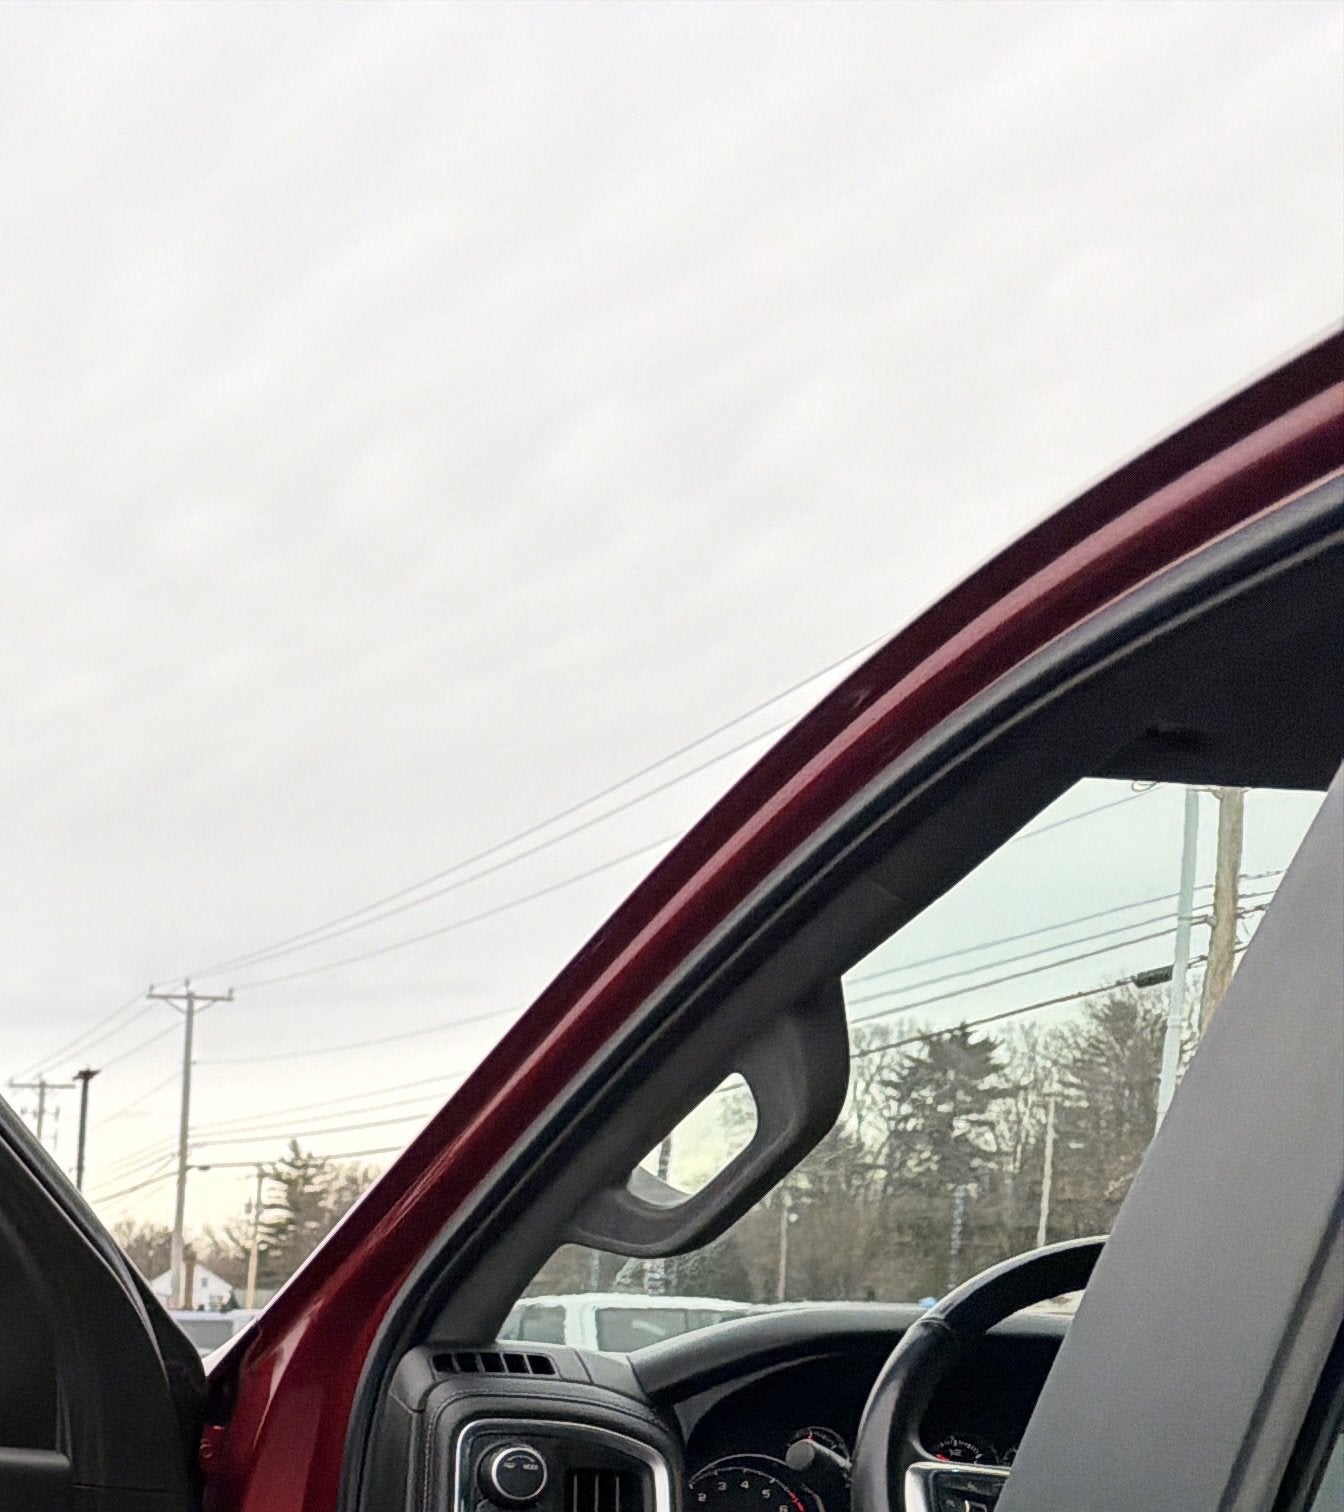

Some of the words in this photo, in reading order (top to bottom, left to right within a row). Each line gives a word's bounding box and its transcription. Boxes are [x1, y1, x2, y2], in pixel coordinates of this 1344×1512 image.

[697, 1492, 707, 1502] 2
[717, 1481, 727, 1491] 3
[740, 1480, 750, 1489] 4
[761, 1489, 771, 1499] 5
